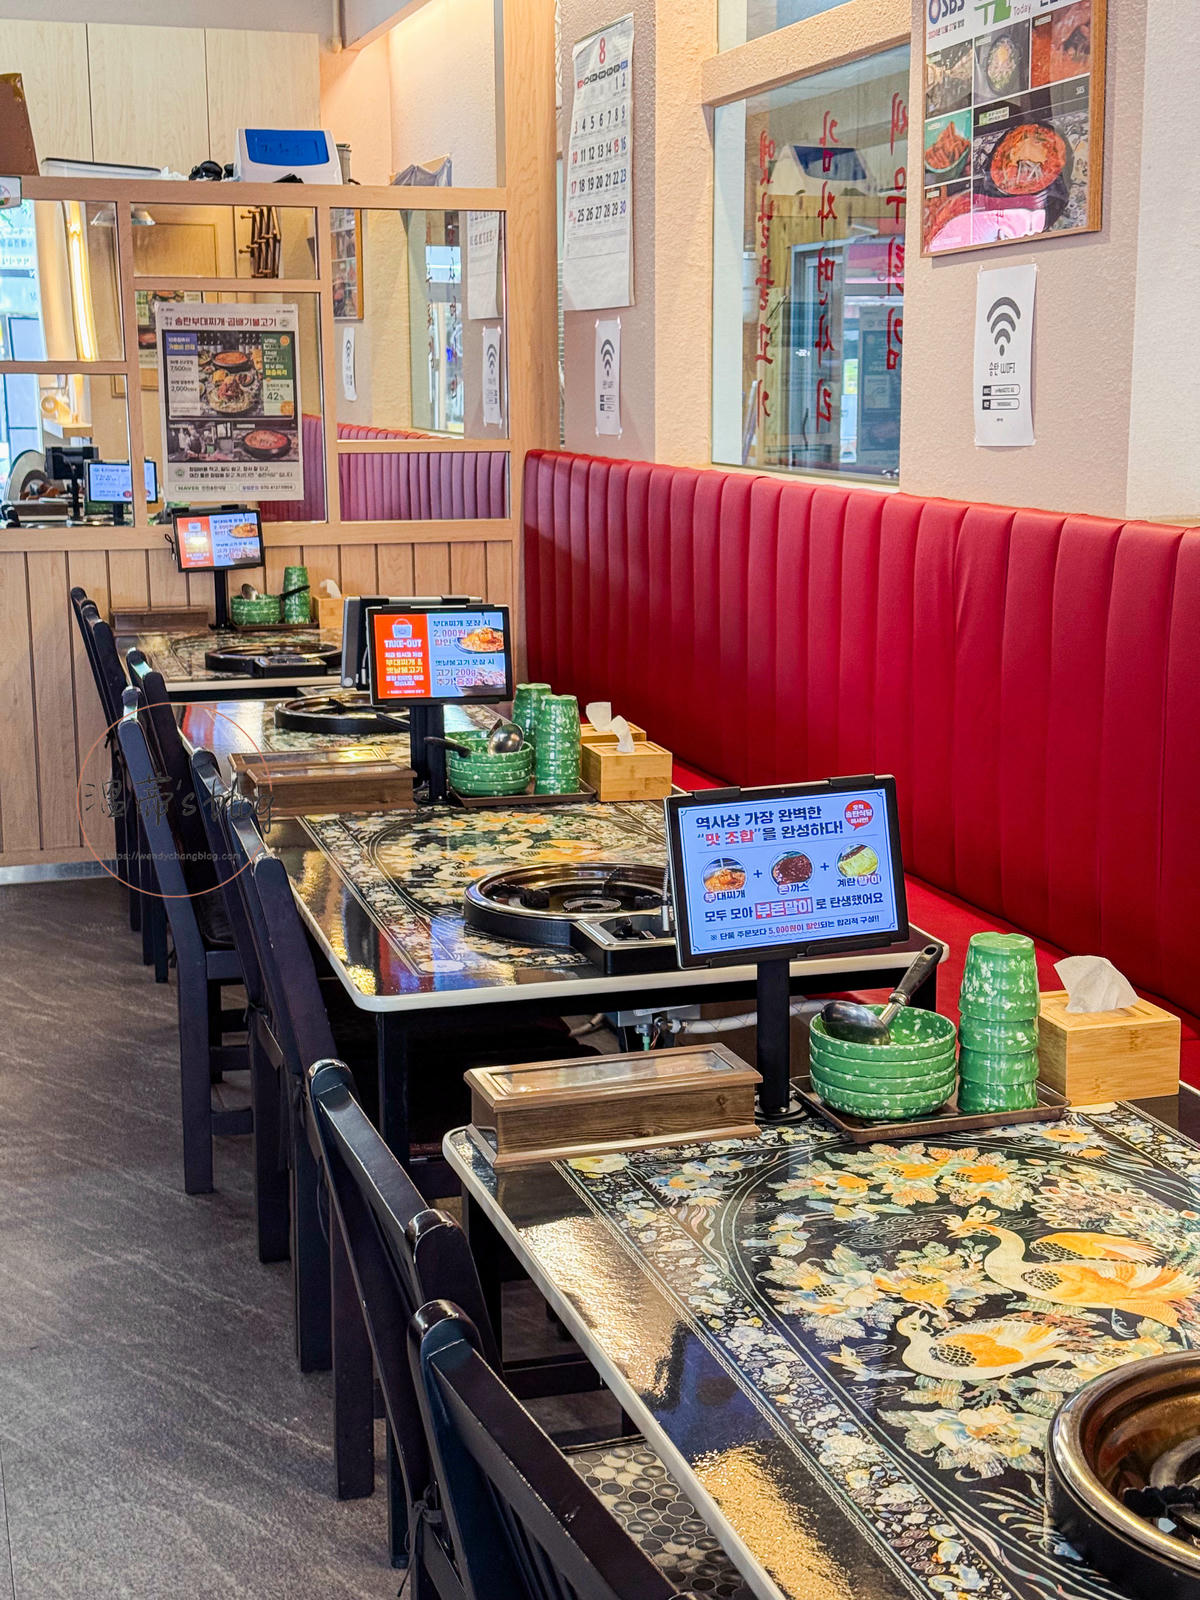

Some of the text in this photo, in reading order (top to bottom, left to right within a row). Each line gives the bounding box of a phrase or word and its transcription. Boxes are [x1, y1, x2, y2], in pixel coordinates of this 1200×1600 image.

[1013, 4, 1032, 17] Today
[599, 37, 606, 64] 8
[580, 148, 586, 162] 11
[589, 146, 595, 160] 12
[597, 143, 604, 158] 13
[605, 141, 612, 156] 14
[571, 168, 627, 194] 17 18 19 20 21 22 23
[577, 208, 585, 222] 25
[586, 207, 593, 221] 26
[595, 205, 602, 220] 27
[603, 203, 610, 218] 28
[611, 202, 618, 216] 29
[619, 200, 627, 214] 30
[384, 639, 422, 648] TAKE-OUT
[436, 668, 477, 677] 고기 200g
[696, 805, 822, 830] 역사상 가장 완벽한
[781, 820, 843, 840] 완성하다!
[704, 909, 729, 923] 모두
[730, 906, 753, 921] 모아
[815, 898, 827, 911] 로
[829, 892, 884, 909] 탄생했어요
